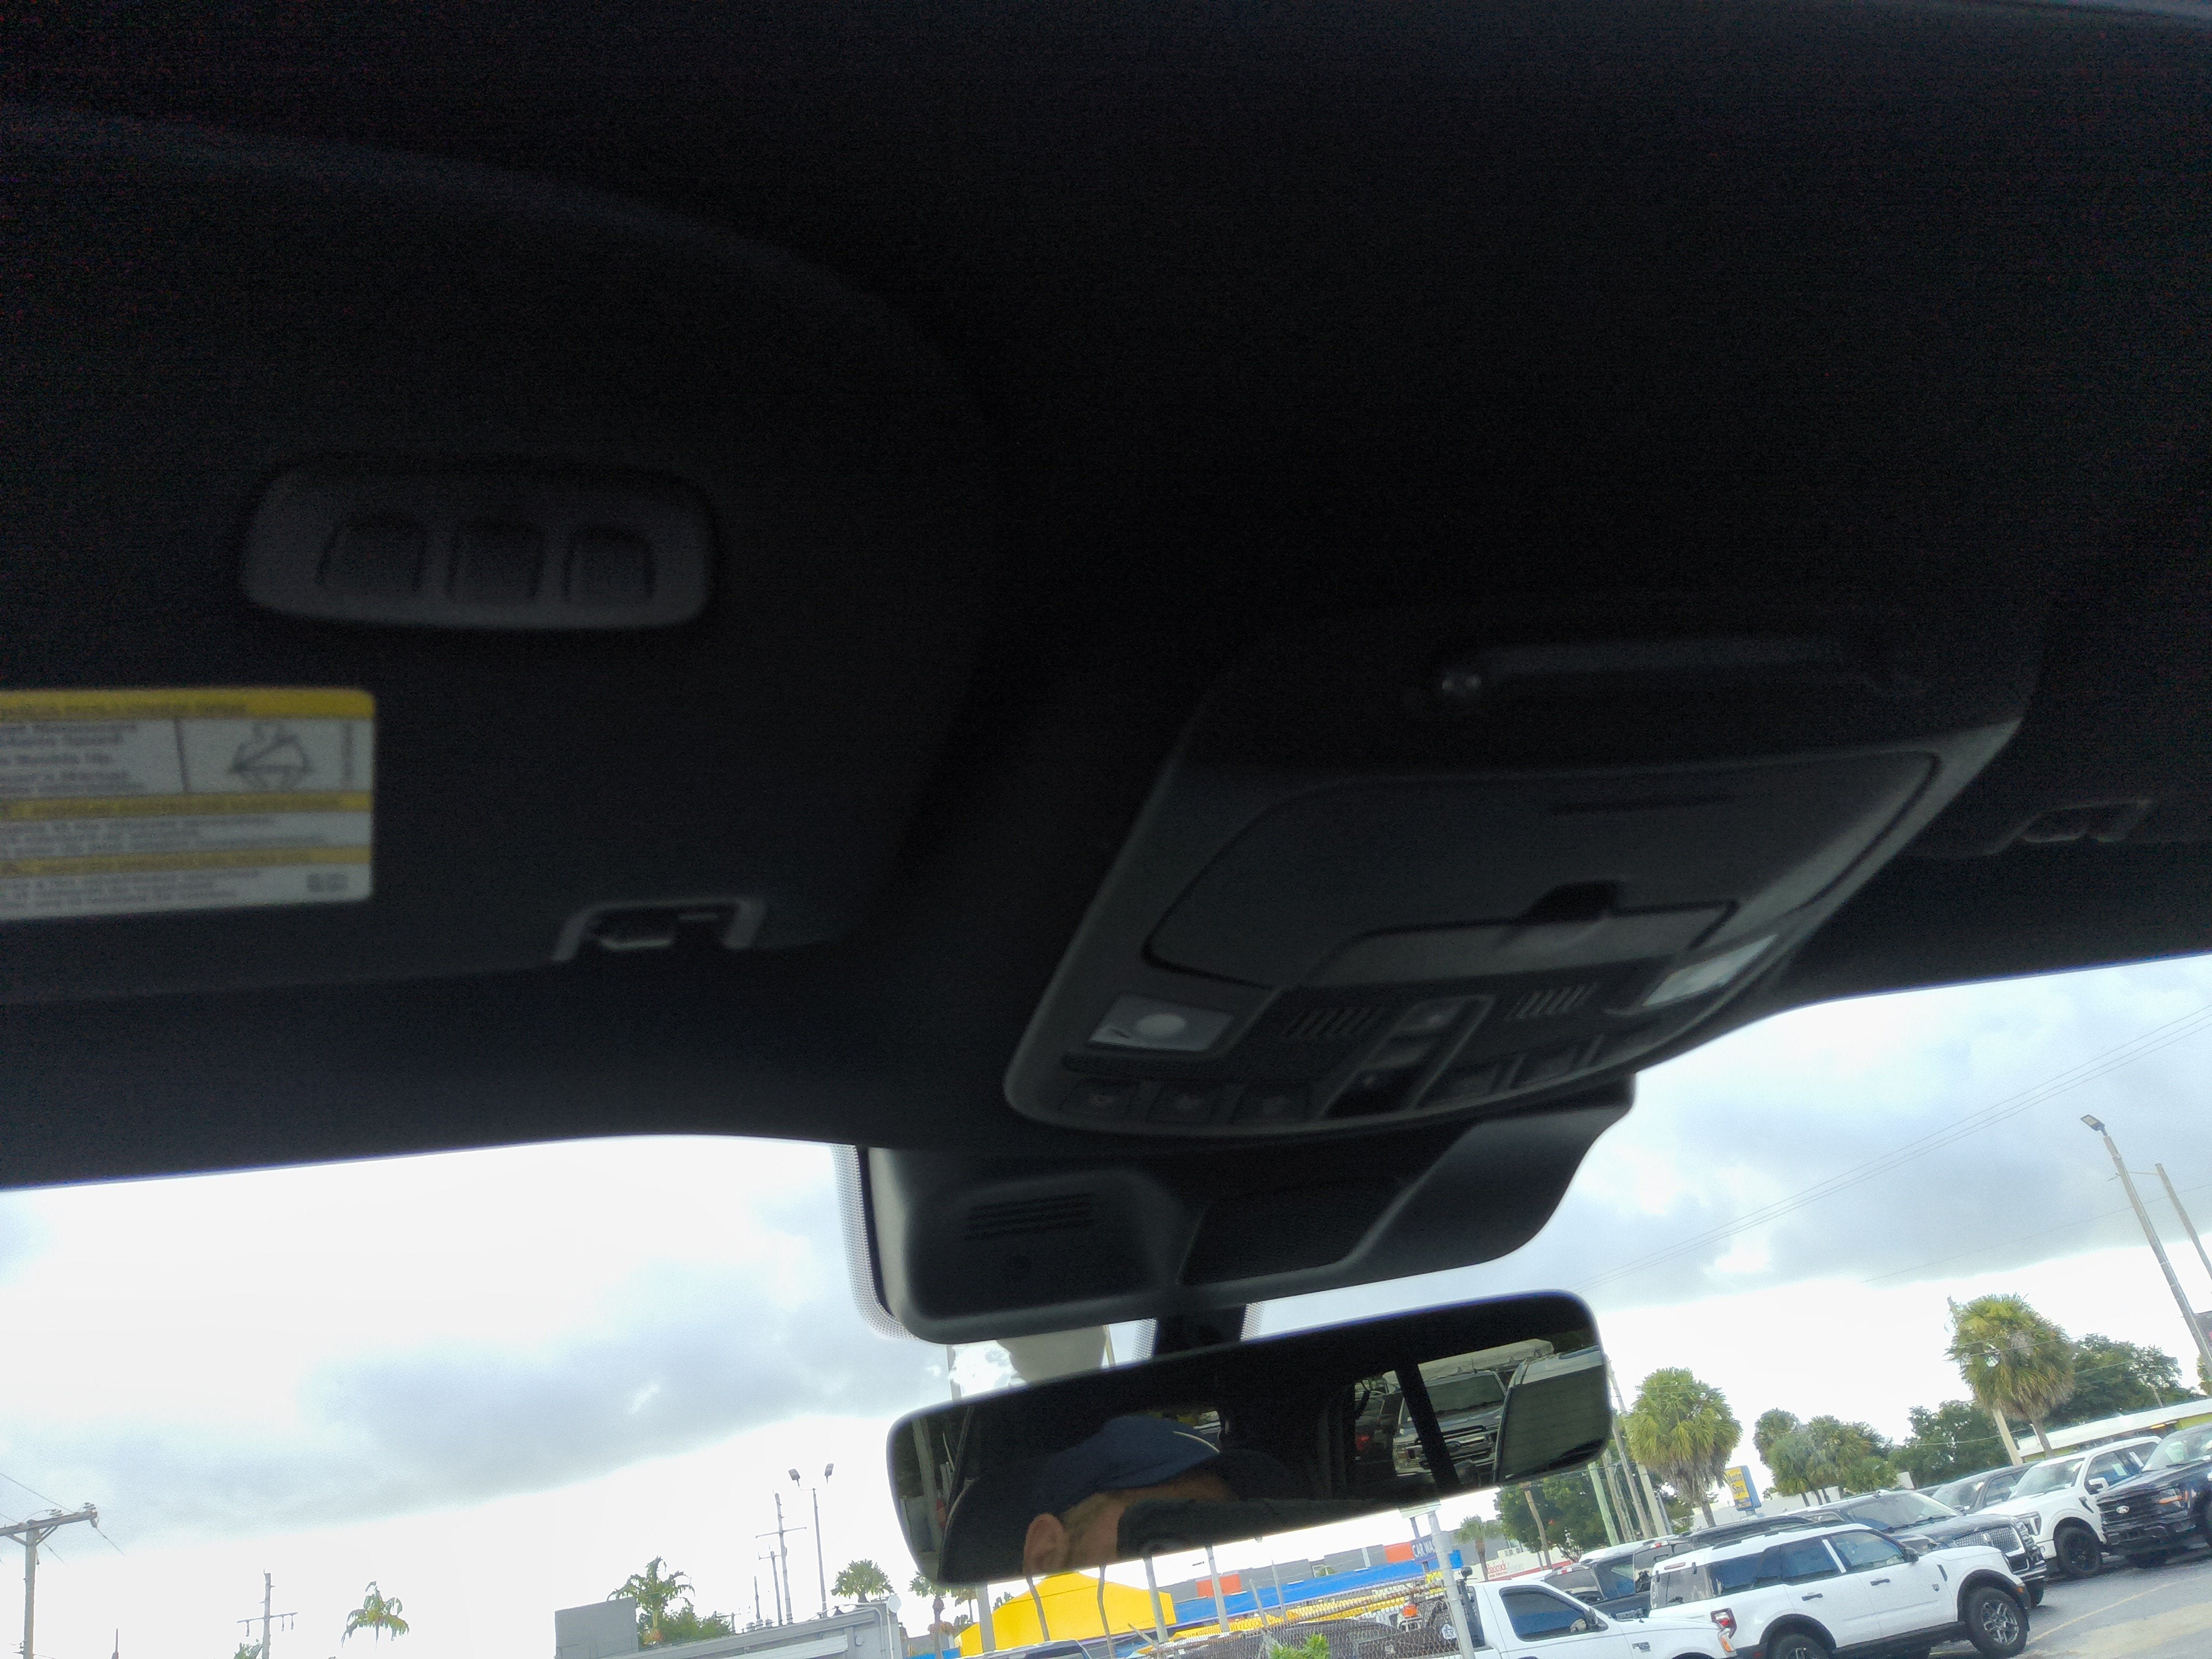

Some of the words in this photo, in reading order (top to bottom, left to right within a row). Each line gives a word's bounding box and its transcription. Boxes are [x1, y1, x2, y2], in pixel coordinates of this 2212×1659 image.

[1732, 1484, 1745, 1496] Spa
[1412, 1543, 1425, 1558] CAR
[1423, 1540, 1436, 1553] WAS
